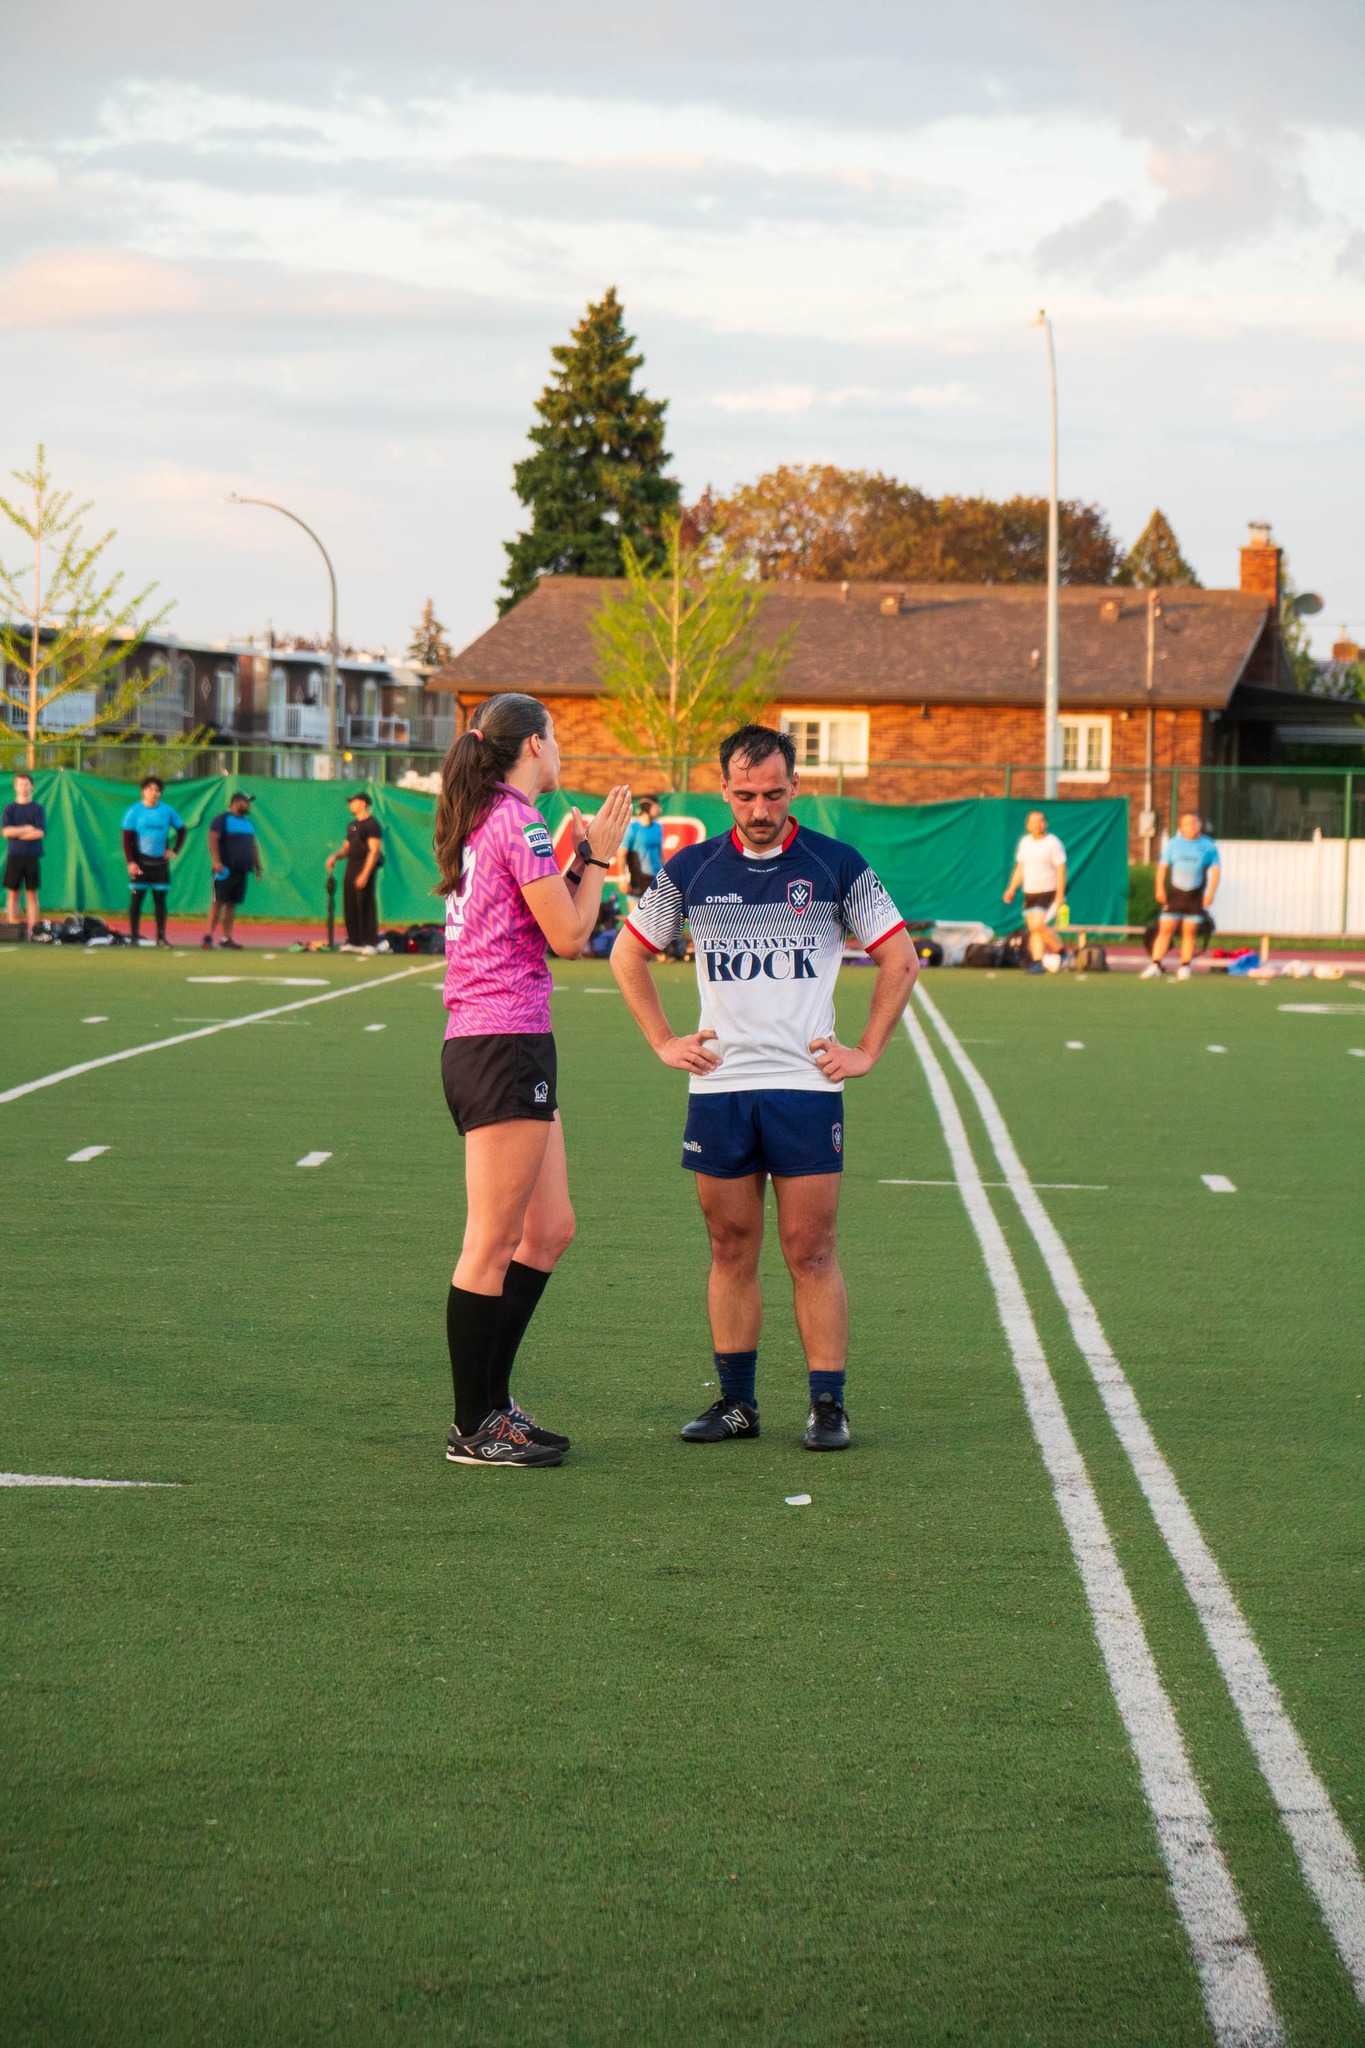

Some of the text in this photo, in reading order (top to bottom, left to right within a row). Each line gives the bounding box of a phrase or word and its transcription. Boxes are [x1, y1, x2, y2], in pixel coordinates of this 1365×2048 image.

[703, 936, 820, 950] LES ENFANTS DU
[703, 948, 820, 982] ROCK
